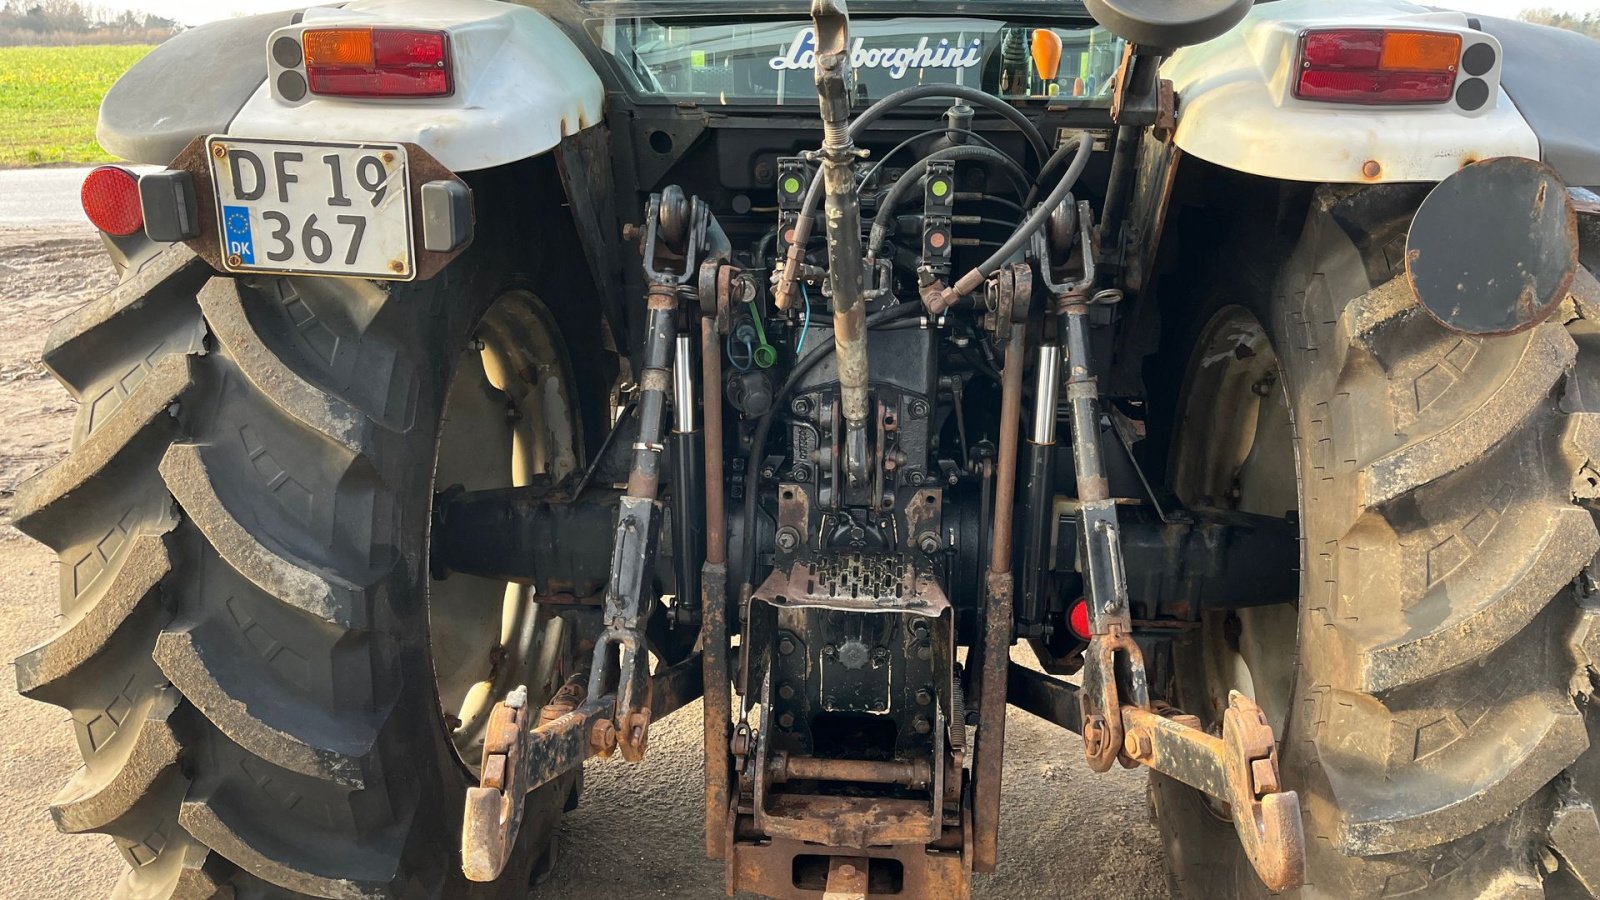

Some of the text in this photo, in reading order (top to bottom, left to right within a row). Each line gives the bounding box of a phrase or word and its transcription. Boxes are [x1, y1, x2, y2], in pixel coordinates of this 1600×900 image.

[769, 27, 981, 79] Laborghini
[228, 149, 388, 208] DF 19
[231, 241, 251, 255] DK
[262, 210, 367, 265] 367
